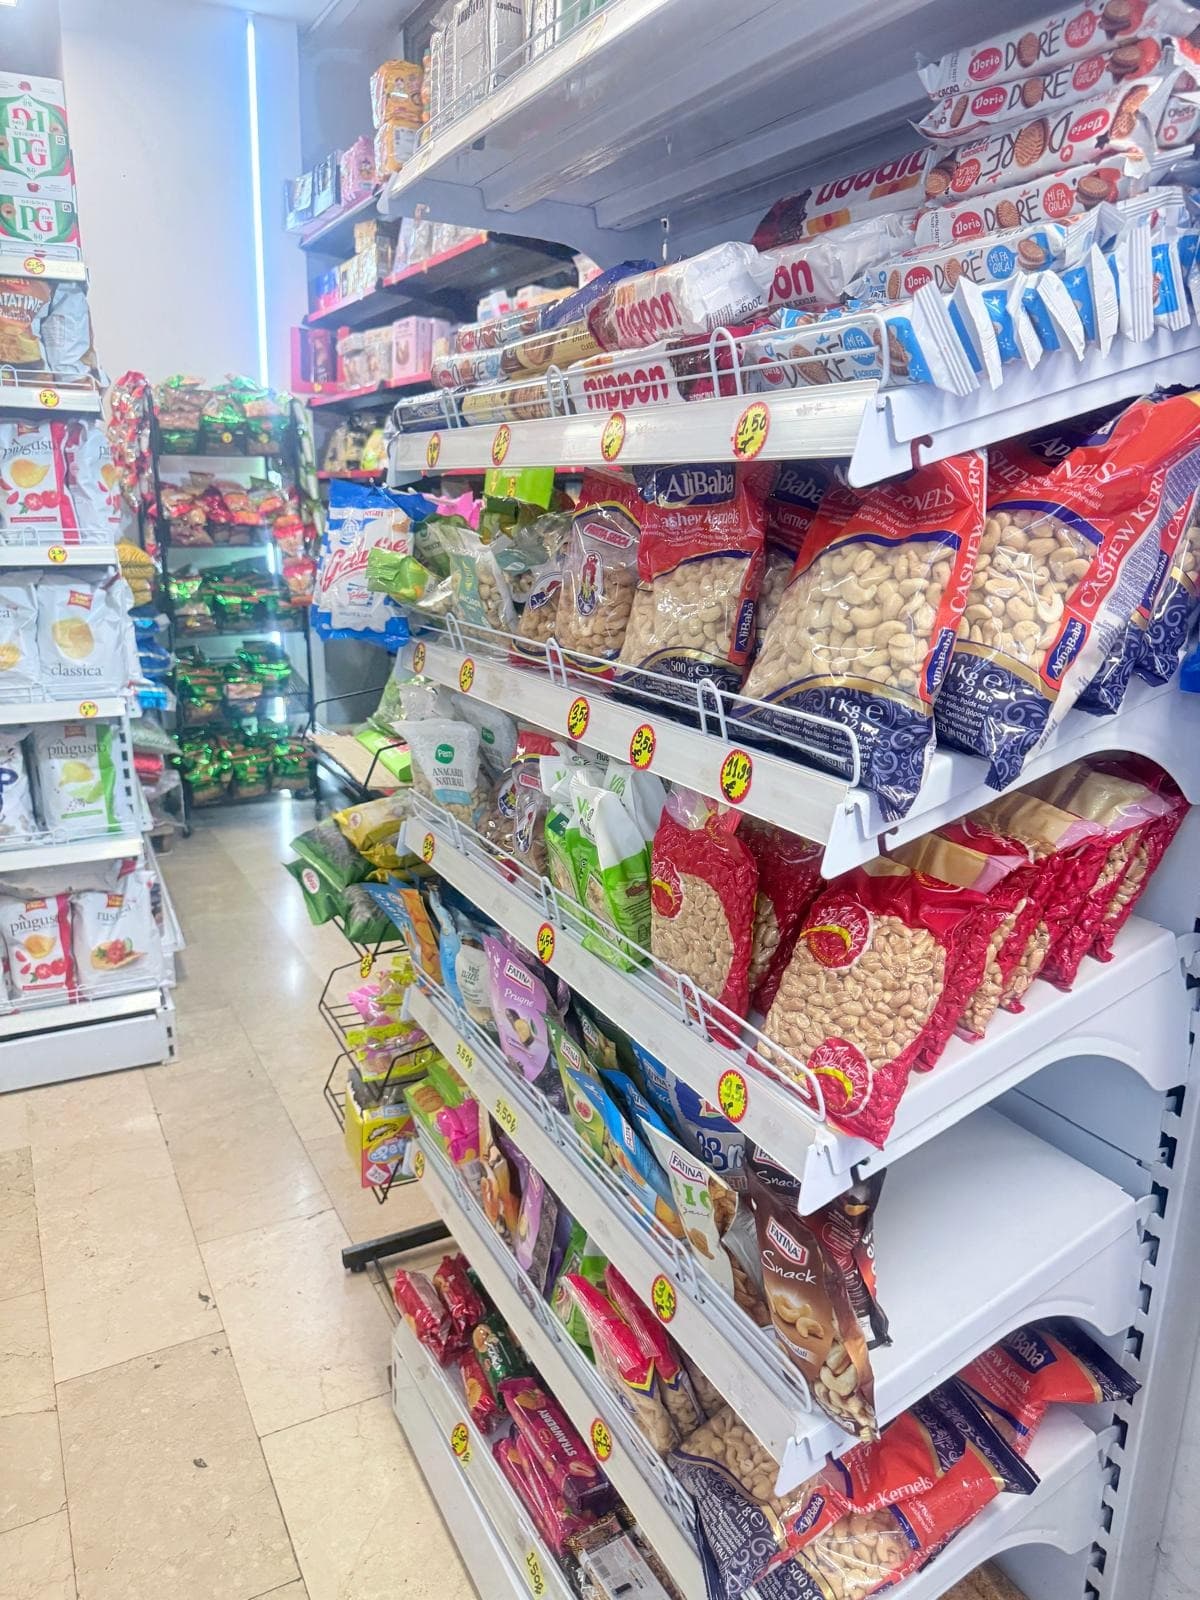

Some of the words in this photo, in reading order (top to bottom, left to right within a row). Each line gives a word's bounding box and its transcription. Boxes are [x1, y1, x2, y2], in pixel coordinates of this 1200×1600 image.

[972, 56, 1000, 74] Doria
[975, 95, 1006, 107] Doria
[1071, 115, 1105, 134] Doria
[12, 138, 47, 166] PG
[1046, 191, 1055, 201] MI
[1055, 189, 1066, 200] FA
[1046, 198, 1072, 213] GOLA!
[20, 205, 53, 232] PG
[954, 219, 981, 236] Doria
[991, 260, 1014, 274] GOLA!
[614, 291, 683, 344] nippon
[583, 365, 670, 412] nippon
[738, 413, 767, 436] 1.50
[664, 469, 735, 498] AliBaba
[950, 520, 984, 614] CASHEW
[1080, 520, 1136, 608] CASHEW
[739, 601, 754, 648] AliBaba
[1051, 620, 1083, 677] ApnaBaba
[51, 663, 102, 677] classica
[671, 660, 687, 674] 500
[956, 663, 979, 688] Kg
[956, 681, 973, 696] 2.2
[838, 699, 861, 719] Kg
[957, 729, 977, 747] ITALY
[438, 749, 454, 759] Pam
[503, 987, 535, 1008] Prugne
[671, 1154, 705, 1182] FATINA
[756, 1170, 801, 1189] Snack
[769, 1225, 801, 1260] FATINA
[760, 1249, 818, 1287] Snack
[536, 1409, 578, 1457] STRAWBERRY
[877, 1476, 934, 1508] Kernels
[797, 1496, 824, 1531] AliBaba
[787, 1562, 808, 1588] 500
